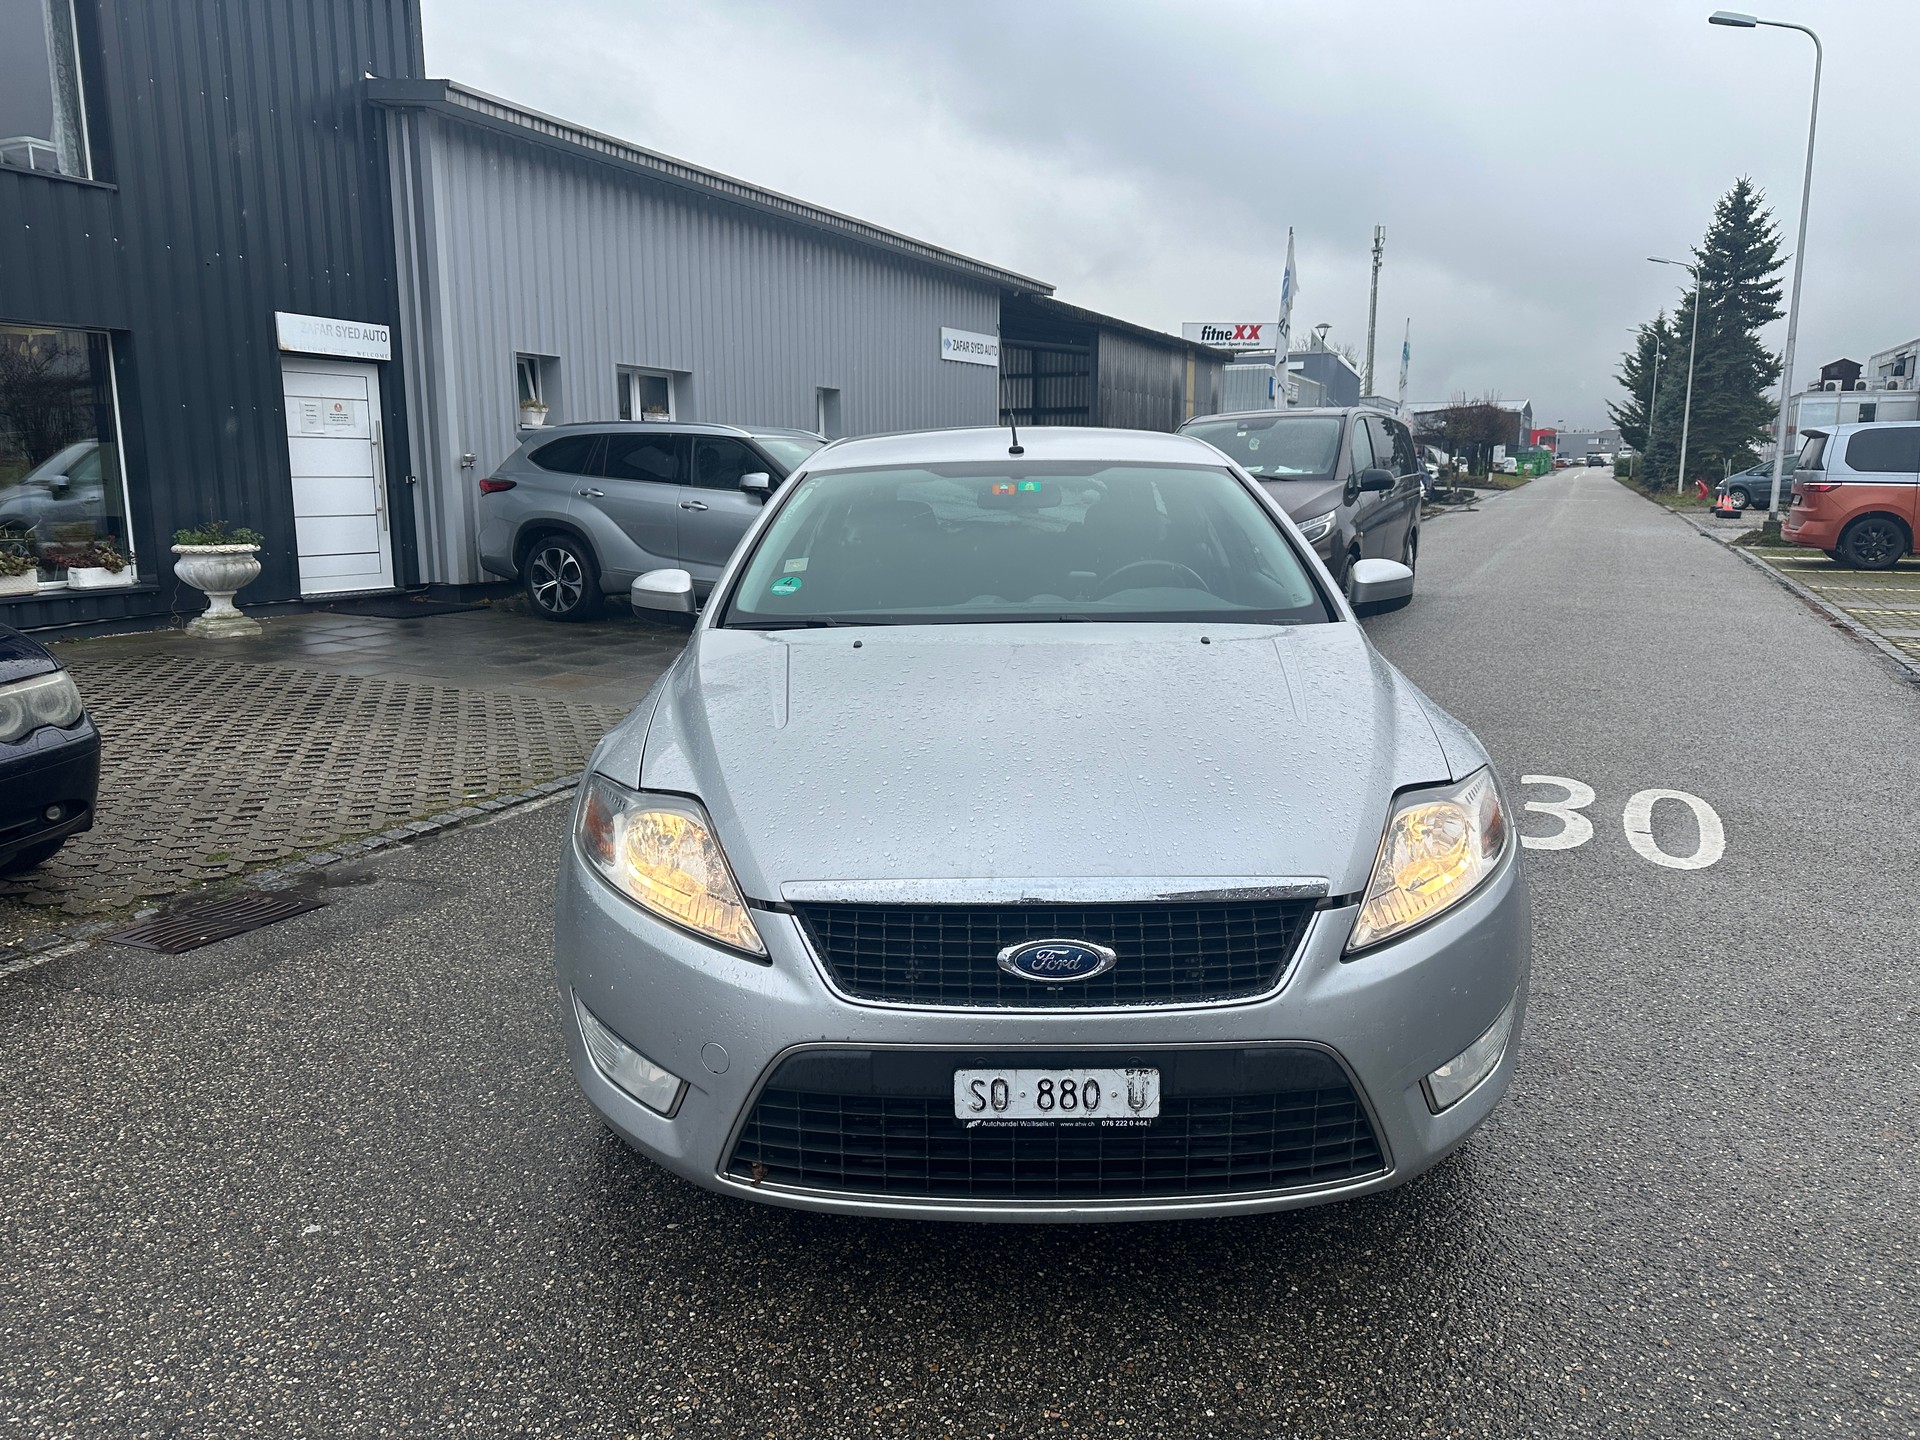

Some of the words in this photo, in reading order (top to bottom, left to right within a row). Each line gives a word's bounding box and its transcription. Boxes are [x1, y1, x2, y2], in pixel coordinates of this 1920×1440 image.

[335, 325, 360, 340] SYED
[362, 328, 388, 343] AUTO
[1201, 325, 1262, 341] fitneXX
[357, 351, 389, 359] WELCOME
[952, 339, 970, 352] ZAFAR
[970, 342, 985, 355] SYED
[985, 344, 998, 357] AUTO
[1521, 784, 1726, 870] 30
[1031, 949, 1083, 971] Ford
[968, 1077, 1009, 1111] SO
[1037, 1077, 1100, 1110] 880
[1127, 1076, 1145, 1111] U
